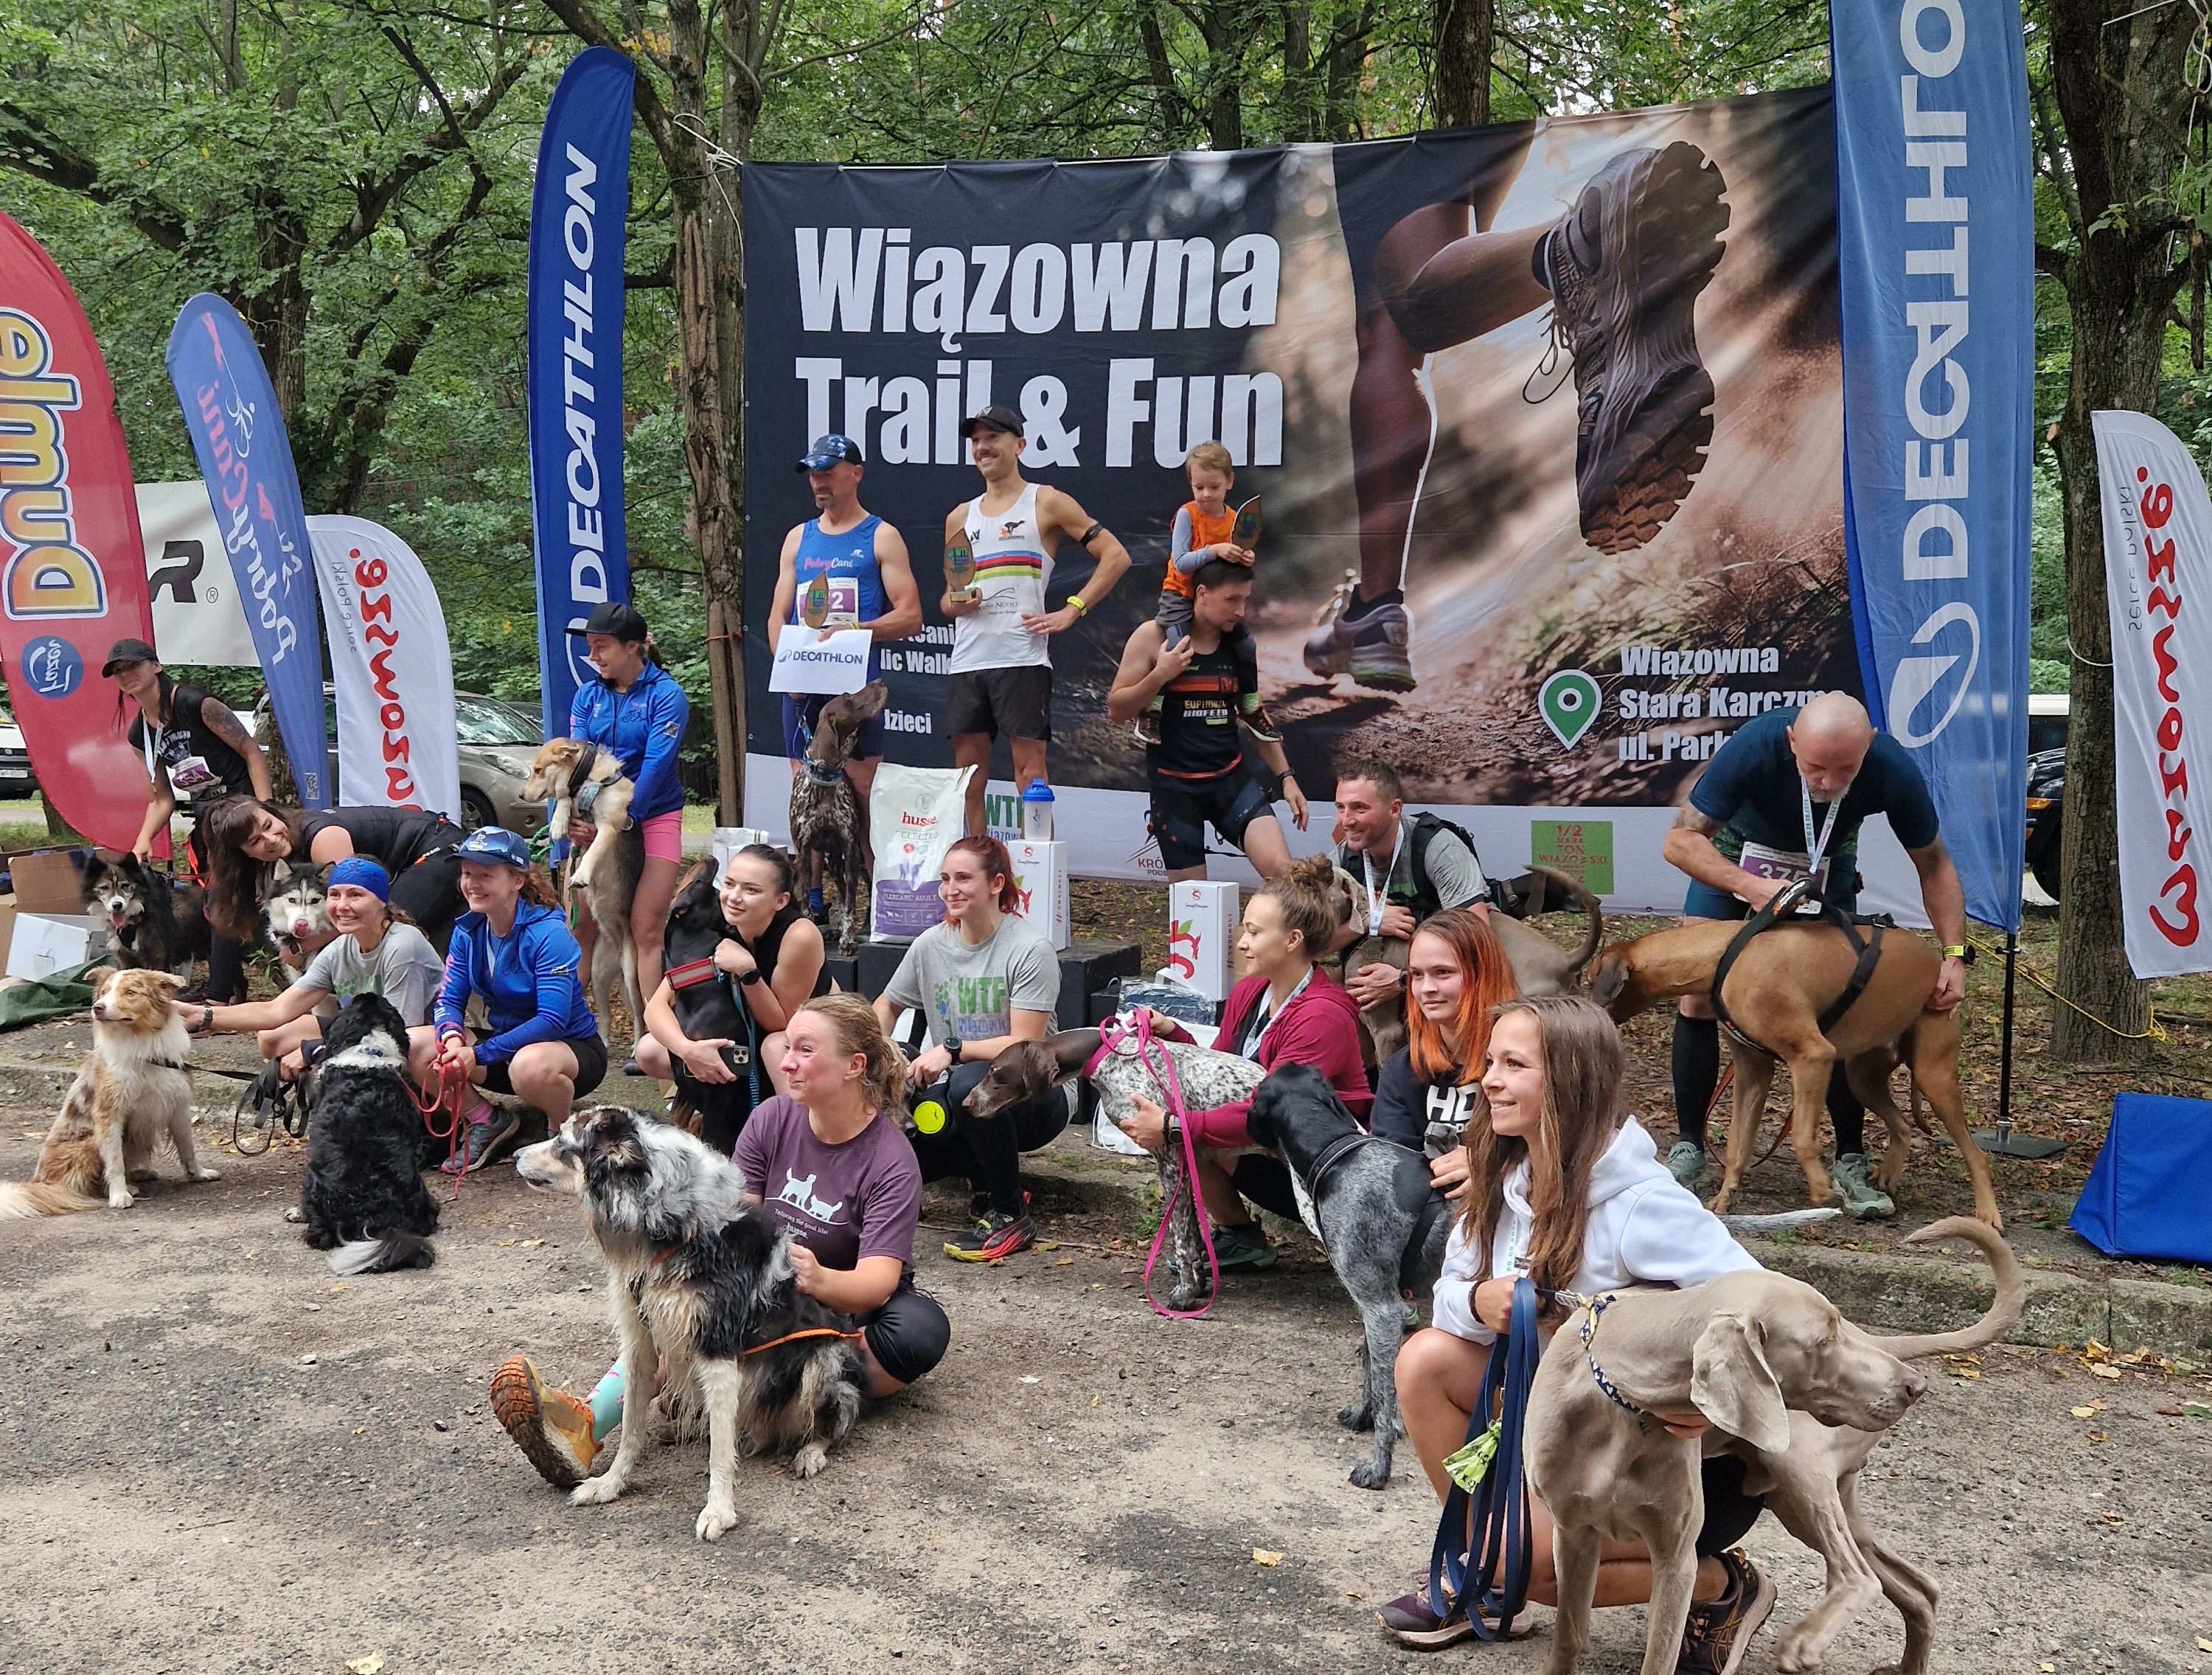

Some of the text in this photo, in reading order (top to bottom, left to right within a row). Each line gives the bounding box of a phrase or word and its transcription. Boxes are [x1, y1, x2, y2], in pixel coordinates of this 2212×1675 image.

[795, 228, 1279, 352] Wiązowna
[564, 142, 608, 603] DECATHLON
[796, 358, 1283, 467] Trail & Fun
[828, 591, 844, 610] 2
[793, 651, 863, 664] DECATHLON
[1621, 646, 1779, 680] Wiązowna
[1619, 687, 1846, 719] Stara Karcz
[1618, 730, 1737, 761] ul. Park
[958, 976, 1006, 1014] WTF
